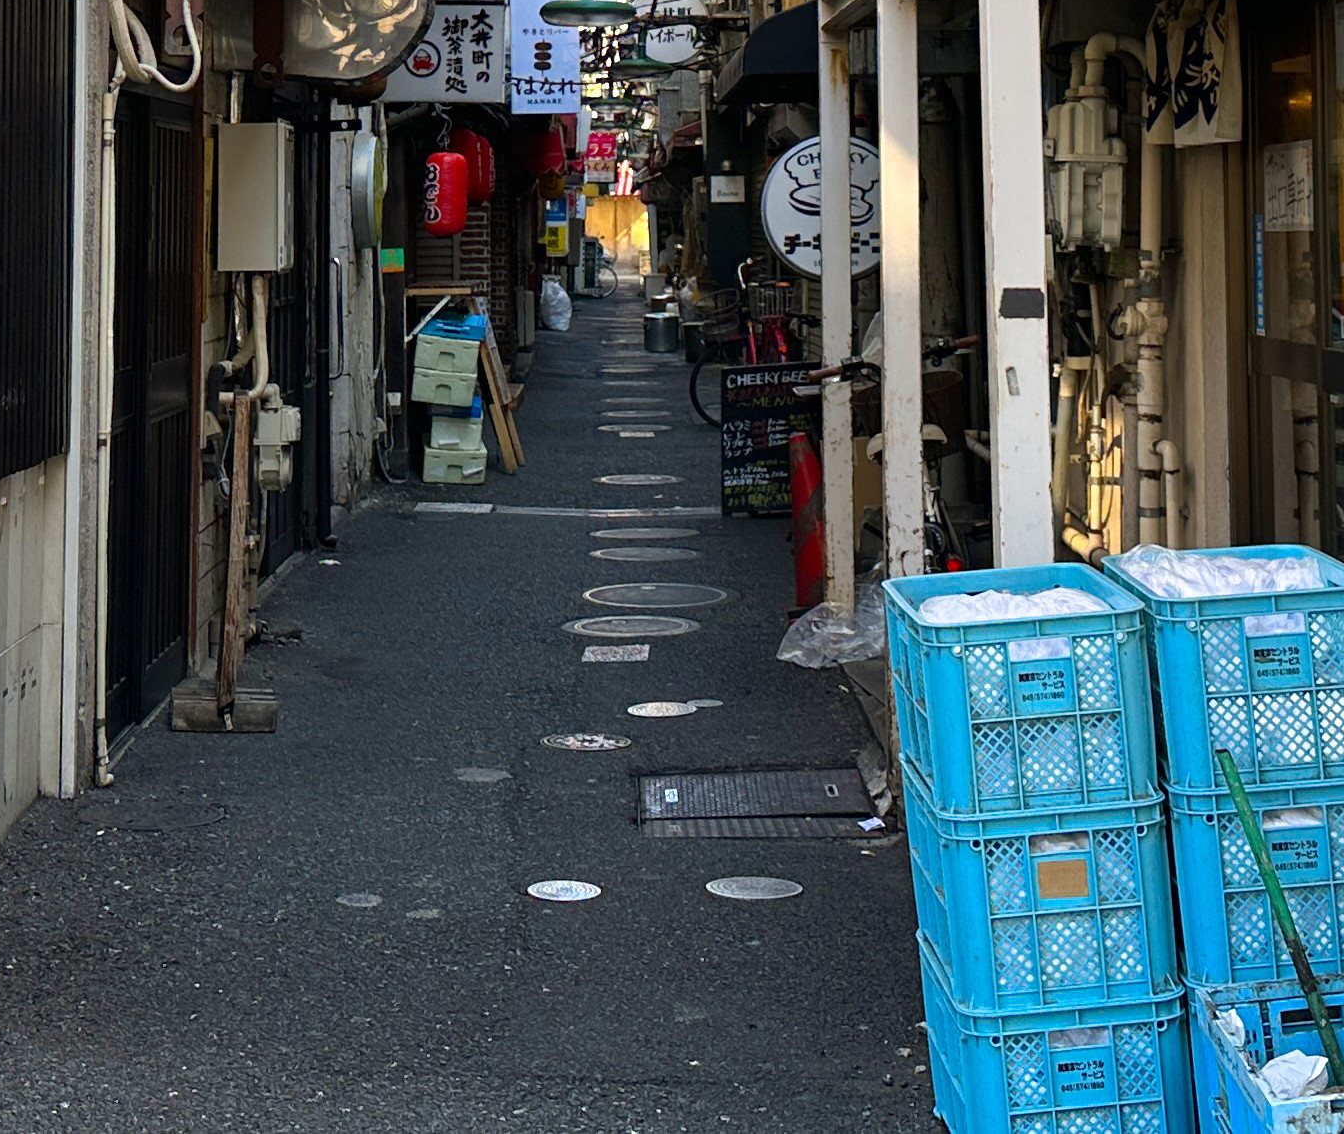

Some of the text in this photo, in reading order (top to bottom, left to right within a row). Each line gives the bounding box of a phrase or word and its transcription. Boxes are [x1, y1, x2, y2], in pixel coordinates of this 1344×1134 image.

[441, 14, 468, 94] 御茶漬処
[470, 8, 494, 83] 大井町の
[513, 75, 576, 95] はなれ
[726, 368, 810, 389] CHEEKY BEE
